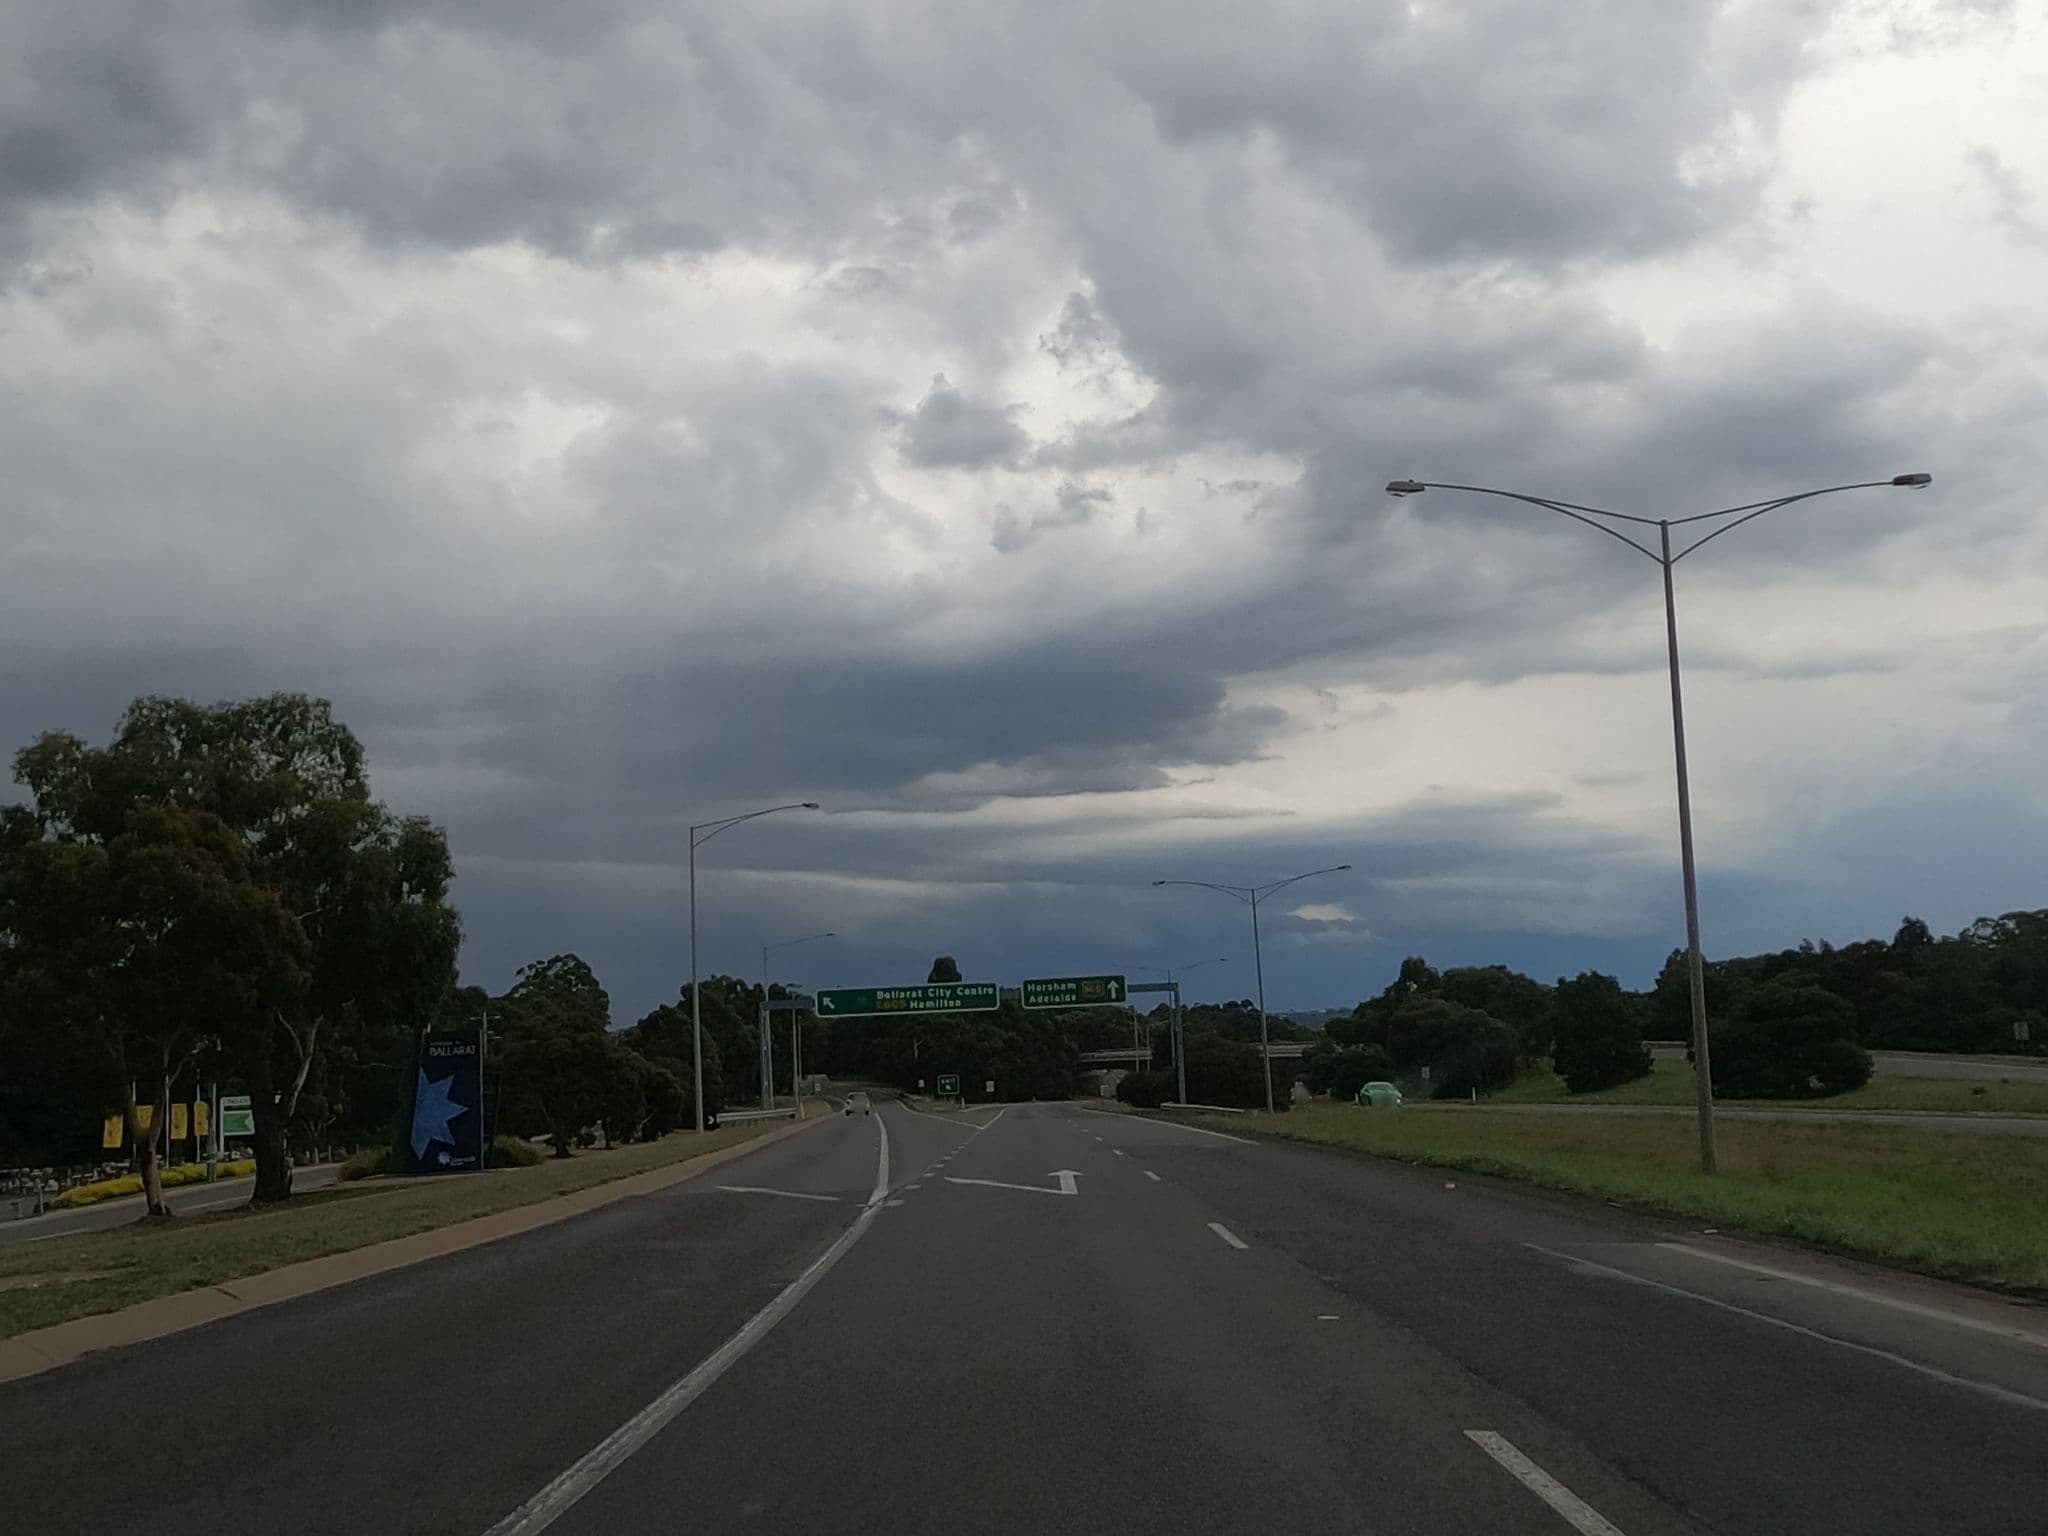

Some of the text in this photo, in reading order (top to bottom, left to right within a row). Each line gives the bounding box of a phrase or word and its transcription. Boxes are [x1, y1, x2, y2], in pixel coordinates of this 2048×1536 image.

[1027, 983, 1077, 992] Horsham
[876, 986, 994, 1000] Ballarat City Centre
[1029, 993, 1077, 1003] Adelaide
[910, 999, 961, 1009] Hamilton
[429, 1045, 476, 1056] BALLARAT
